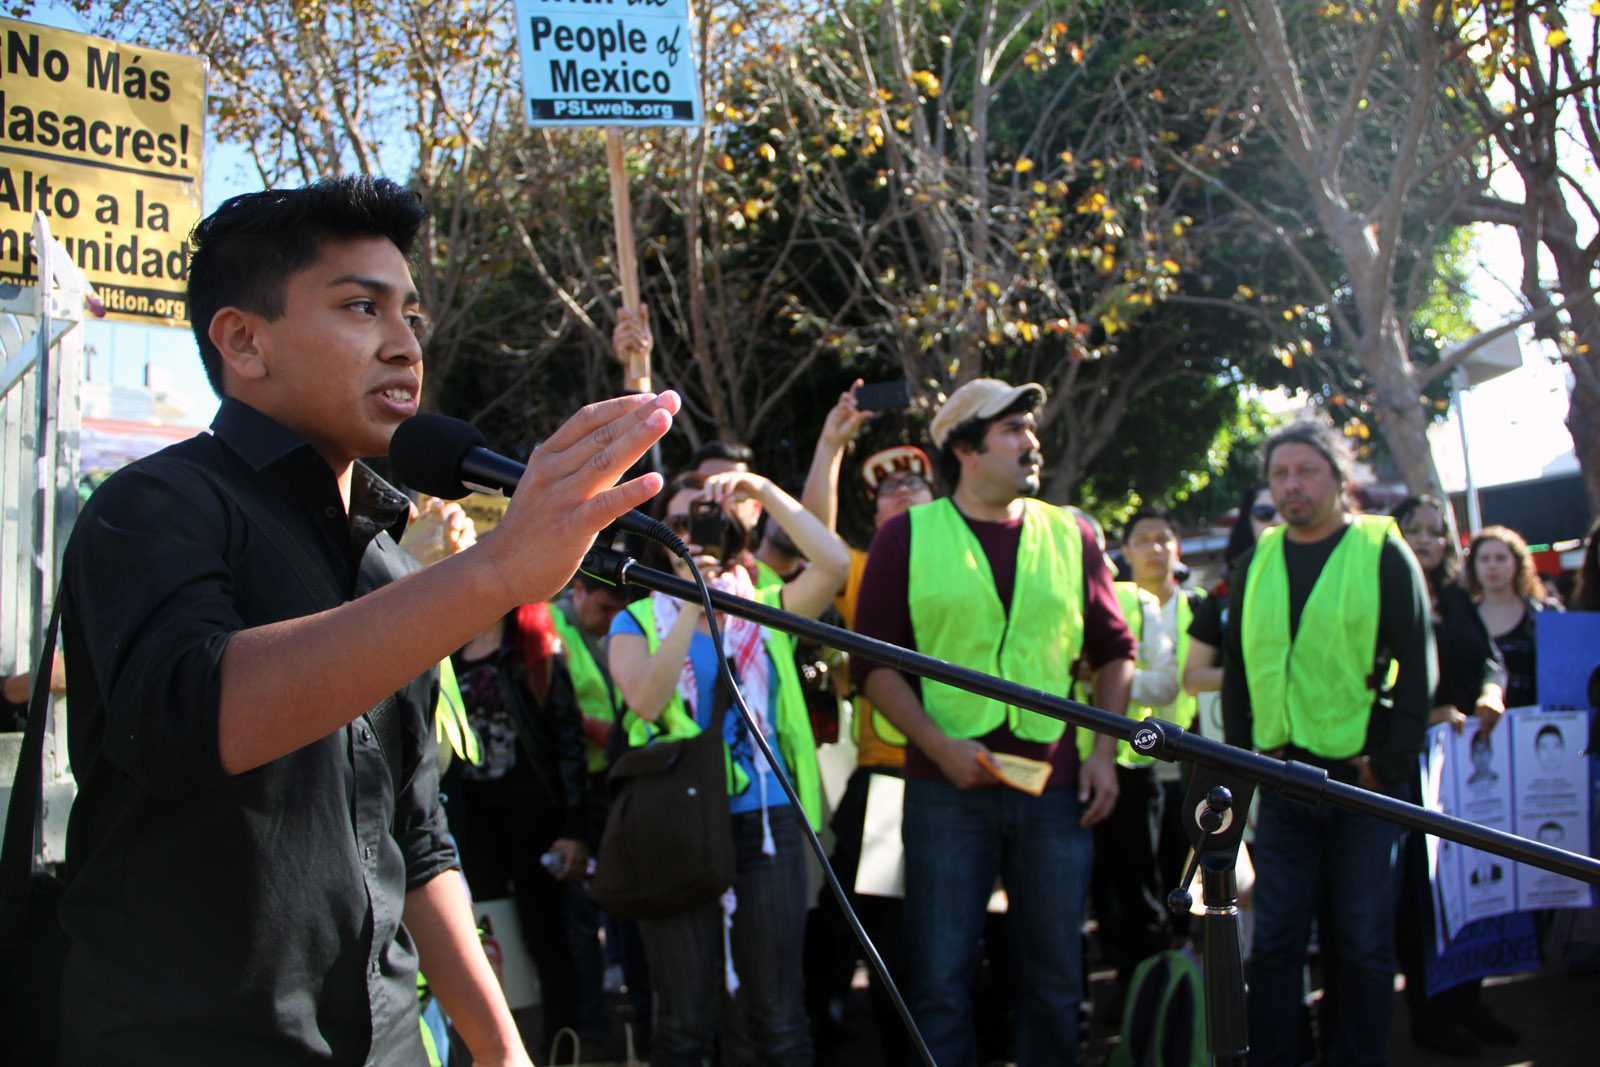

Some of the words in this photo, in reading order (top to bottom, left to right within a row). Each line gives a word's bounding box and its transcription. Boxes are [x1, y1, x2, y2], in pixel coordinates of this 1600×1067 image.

[531, 17, 647, 61] People
[657, 25, 682, 67] of
[0, 30, 69, 82] No
[87, 46, 170, 102] Más
[550, 60, 670, 94] Mexico
[0, 89, 189, 169] asacres!
[554, 101, 674, 119] PSLweb.org
[95, 194, 119, 225] a
[136, 190, 169, 232] la
[97, 287, 186, 320] lition.org
[1134, 733, 1158, 746] K&M
